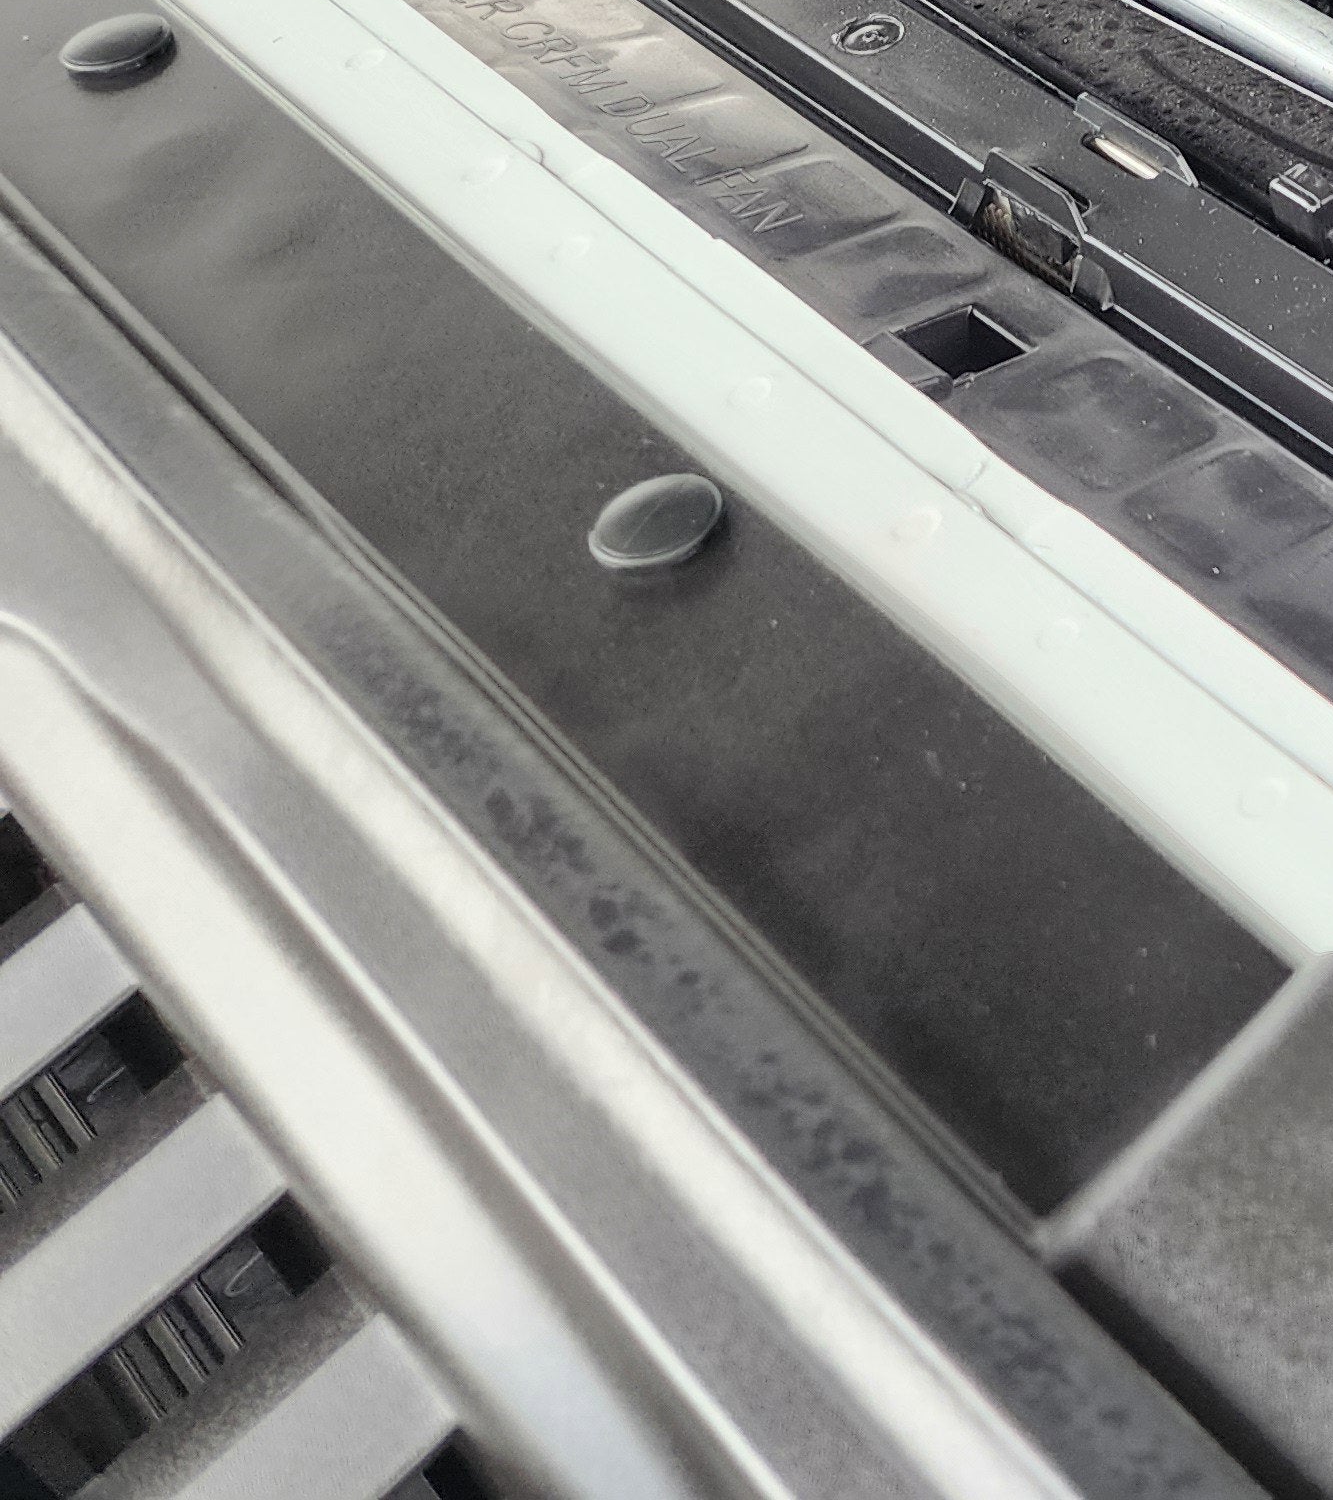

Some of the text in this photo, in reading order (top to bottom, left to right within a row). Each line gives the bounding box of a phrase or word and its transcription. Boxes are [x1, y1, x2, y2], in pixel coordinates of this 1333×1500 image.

[501, 21, 629, 97] CRFM
[598, 92, 717, 173] DUAL
[692, 167, 804, 235] FAN
